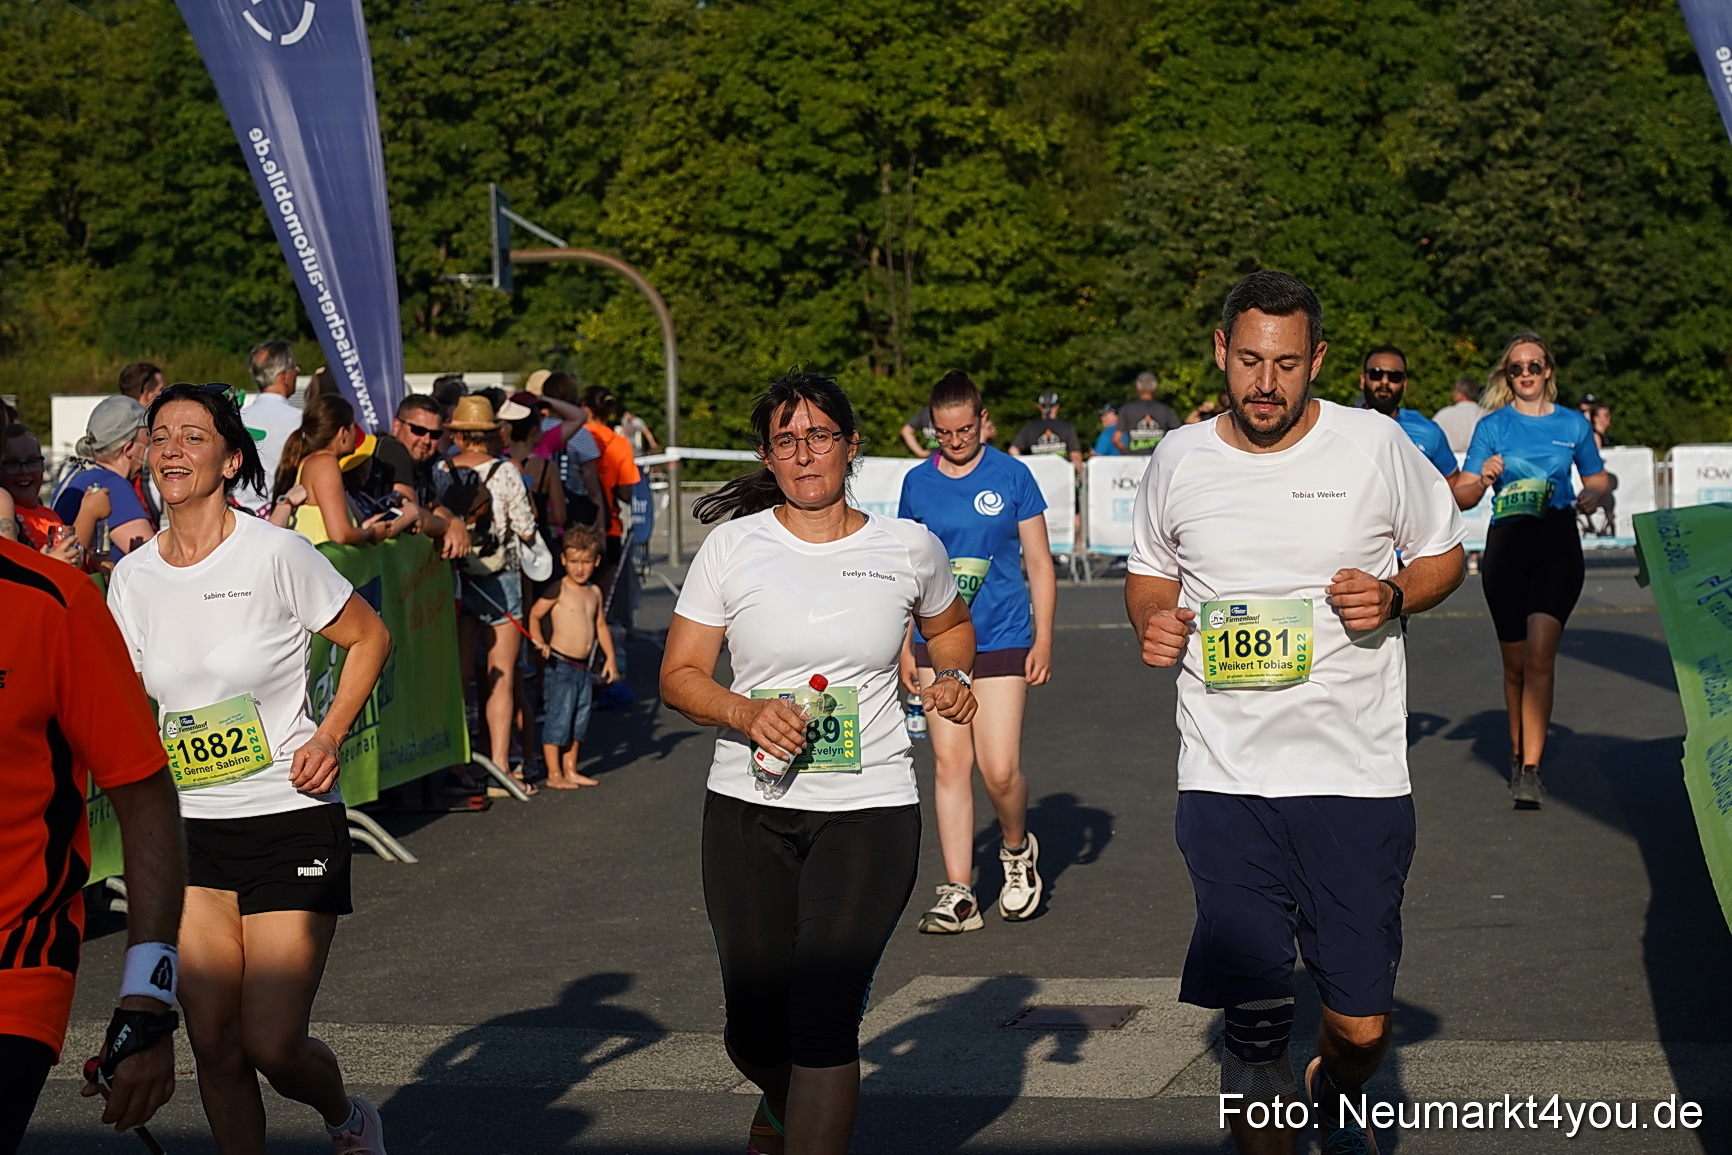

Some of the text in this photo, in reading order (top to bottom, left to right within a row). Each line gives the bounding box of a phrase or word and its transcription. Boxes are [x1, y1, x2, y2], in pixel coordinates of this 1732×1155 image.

[1291, 490, 1347, 499] Tobias Weikert
[1505, 491, 1538, 506] 1813
[842, 570, 896, 581] Evelyn Schunda
[954, 574, 978, 591] 60
[203, 590, 252, 601] Sabine Gerner
[1218, 628, 1289, 659] 1881
[1296, 633, 1307, 672] 2022
[1207, 635, 1217, 677] WALK
[1218, 660, 1293, 671] Weikert Tobias
[805, 716, 840, 743] 89
[843, 719, 854, 758] 2022
[176, 727, 248, 765] 1882
[246, 726, 266, 763] 2022
[810, 746, 844, 757] Evelyn
[166, 744, 183, 781] WALK
[184, 764, 214, 776] Gerner
[216, 755, 251, 770] Sabine
[297, 866, 323, 877] PUMA
